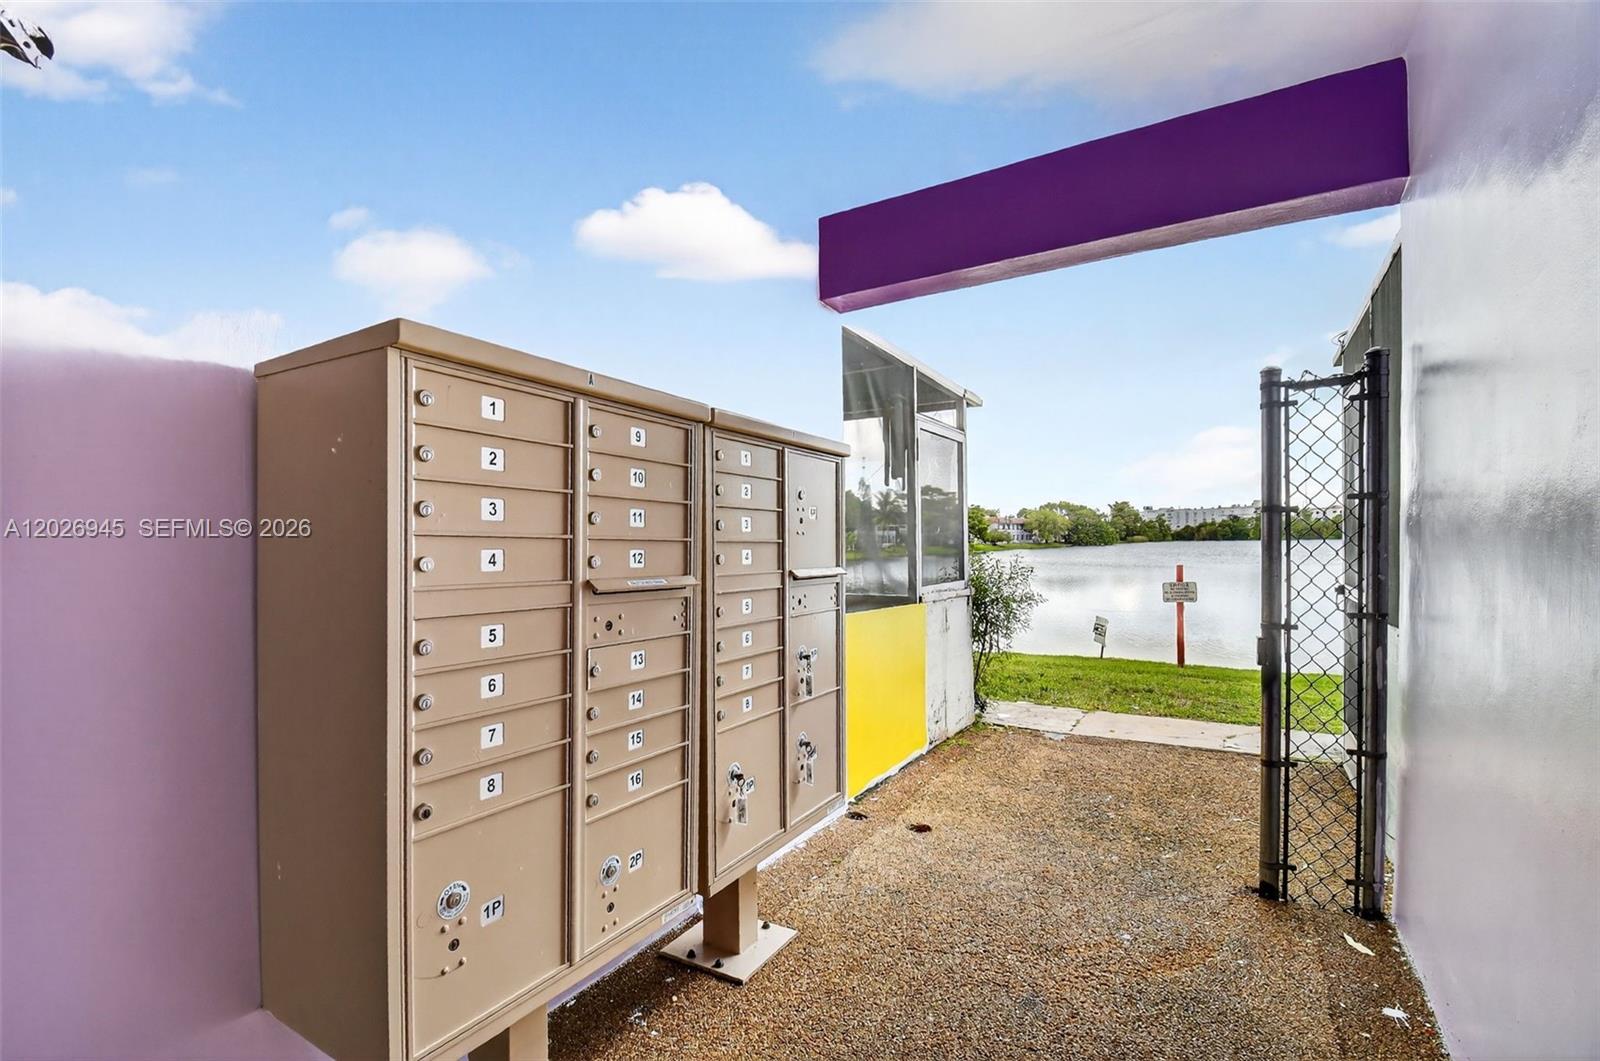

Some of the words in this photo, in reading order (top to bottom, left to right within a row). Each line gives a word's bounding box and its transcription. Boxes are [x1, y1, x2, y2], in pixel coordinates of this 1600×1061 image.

[587, 372, 595, 387] A
[489, 400, 497, 416] 1
[635, 430, 642, 443] 9
[489, 451, 497, 466] 2
[744, 453, 748, 463] 1
[632, 471, 644, 484] 10
[744, 486, 749, 497] 2
[488, 501, 497, 517] 3
[632, 512, 643, 523] 11
[488, 552, 497, 567] 4
[632, 552, 643, 564] 12
[744, 552, 750, 561] 4
[488, 628, 497, 643] 5
[631, 653, 644, 667] 13
[745, 666, 750, 676] 7
[487, 678, 497, 693] 6
[631, 692, 642, 706] 14
[745, 698, 750, 709] 8
[488, 727, 497, 743] 7
[630, 731, 642, 745] 15
[487, 777, 496, 793] 8
[630, 772, 642, 786] 16
[630, 853, 641, 868] 2P
[484, 900, 501, 919] 1P
